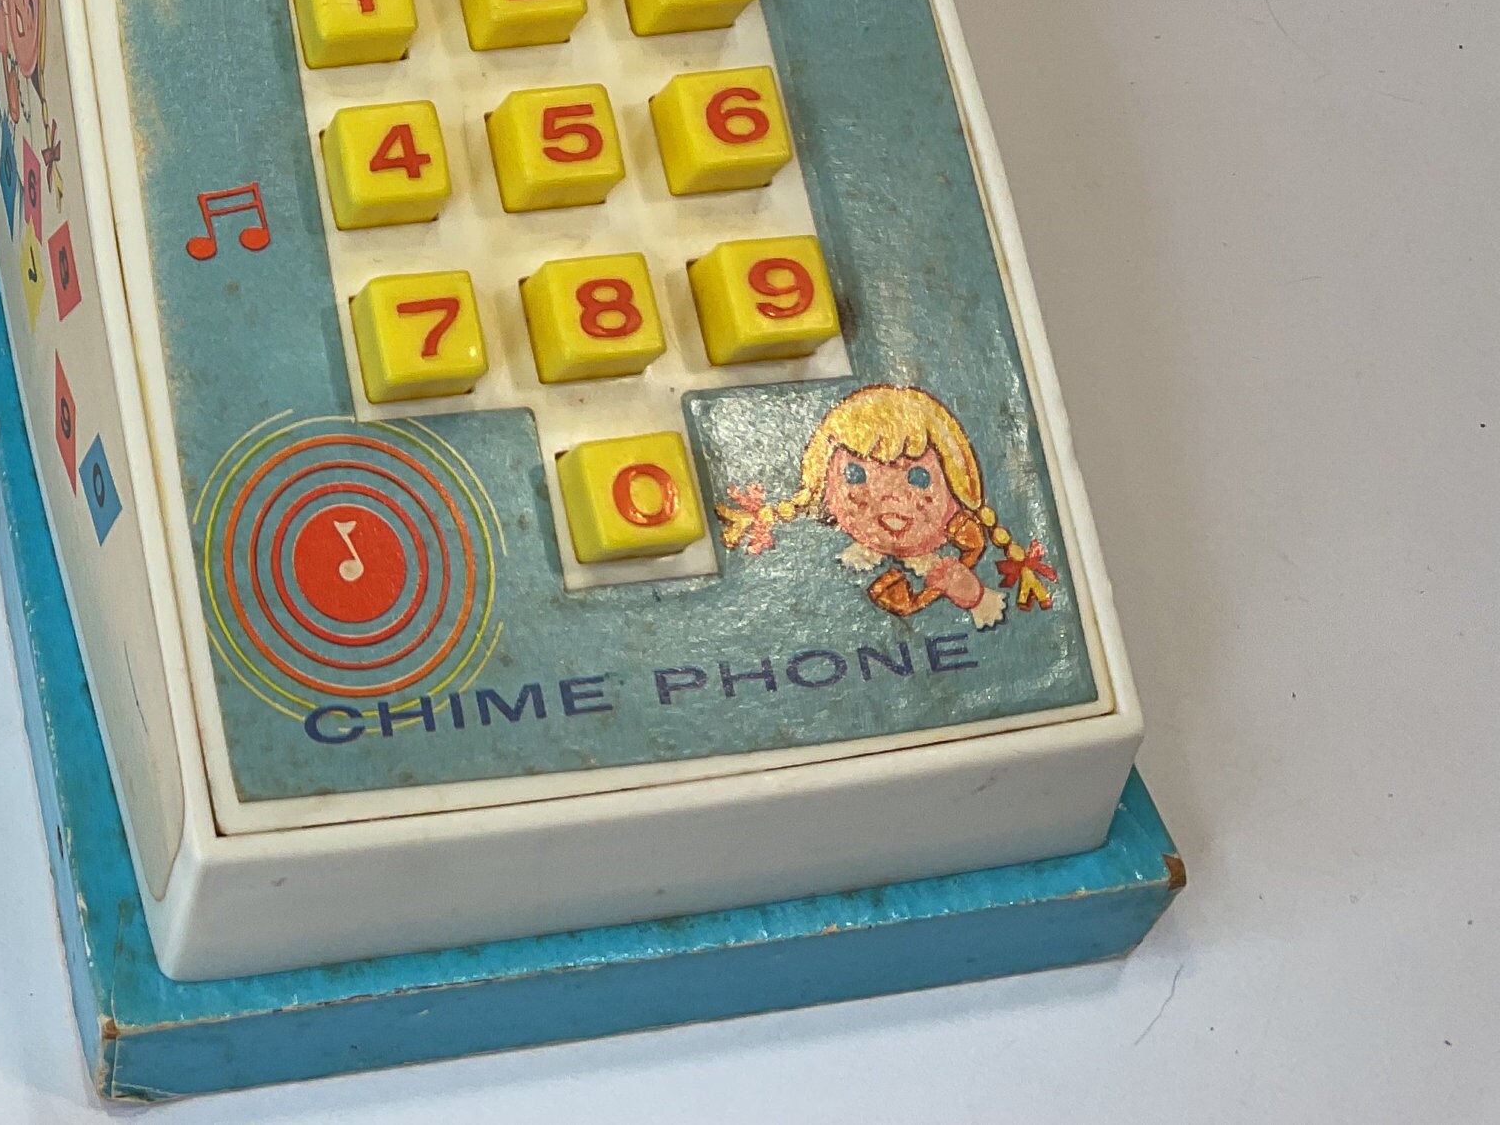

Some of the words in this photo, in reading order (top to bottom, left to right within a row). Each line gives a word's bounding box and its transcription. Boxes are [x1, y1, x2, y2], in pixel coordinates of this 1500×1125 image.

[369, 124, 431, 179] 4
[543, 103, 604, 162] 5
[706, 87, 770, 144] 6
[396, 296, 461, 358] 7
[575, 278, 643, 339] 8
[748, 257, 815, 319] 9
[303, 676, 613, 745] CHIME
[656, 632, 980, 706] PHONE
